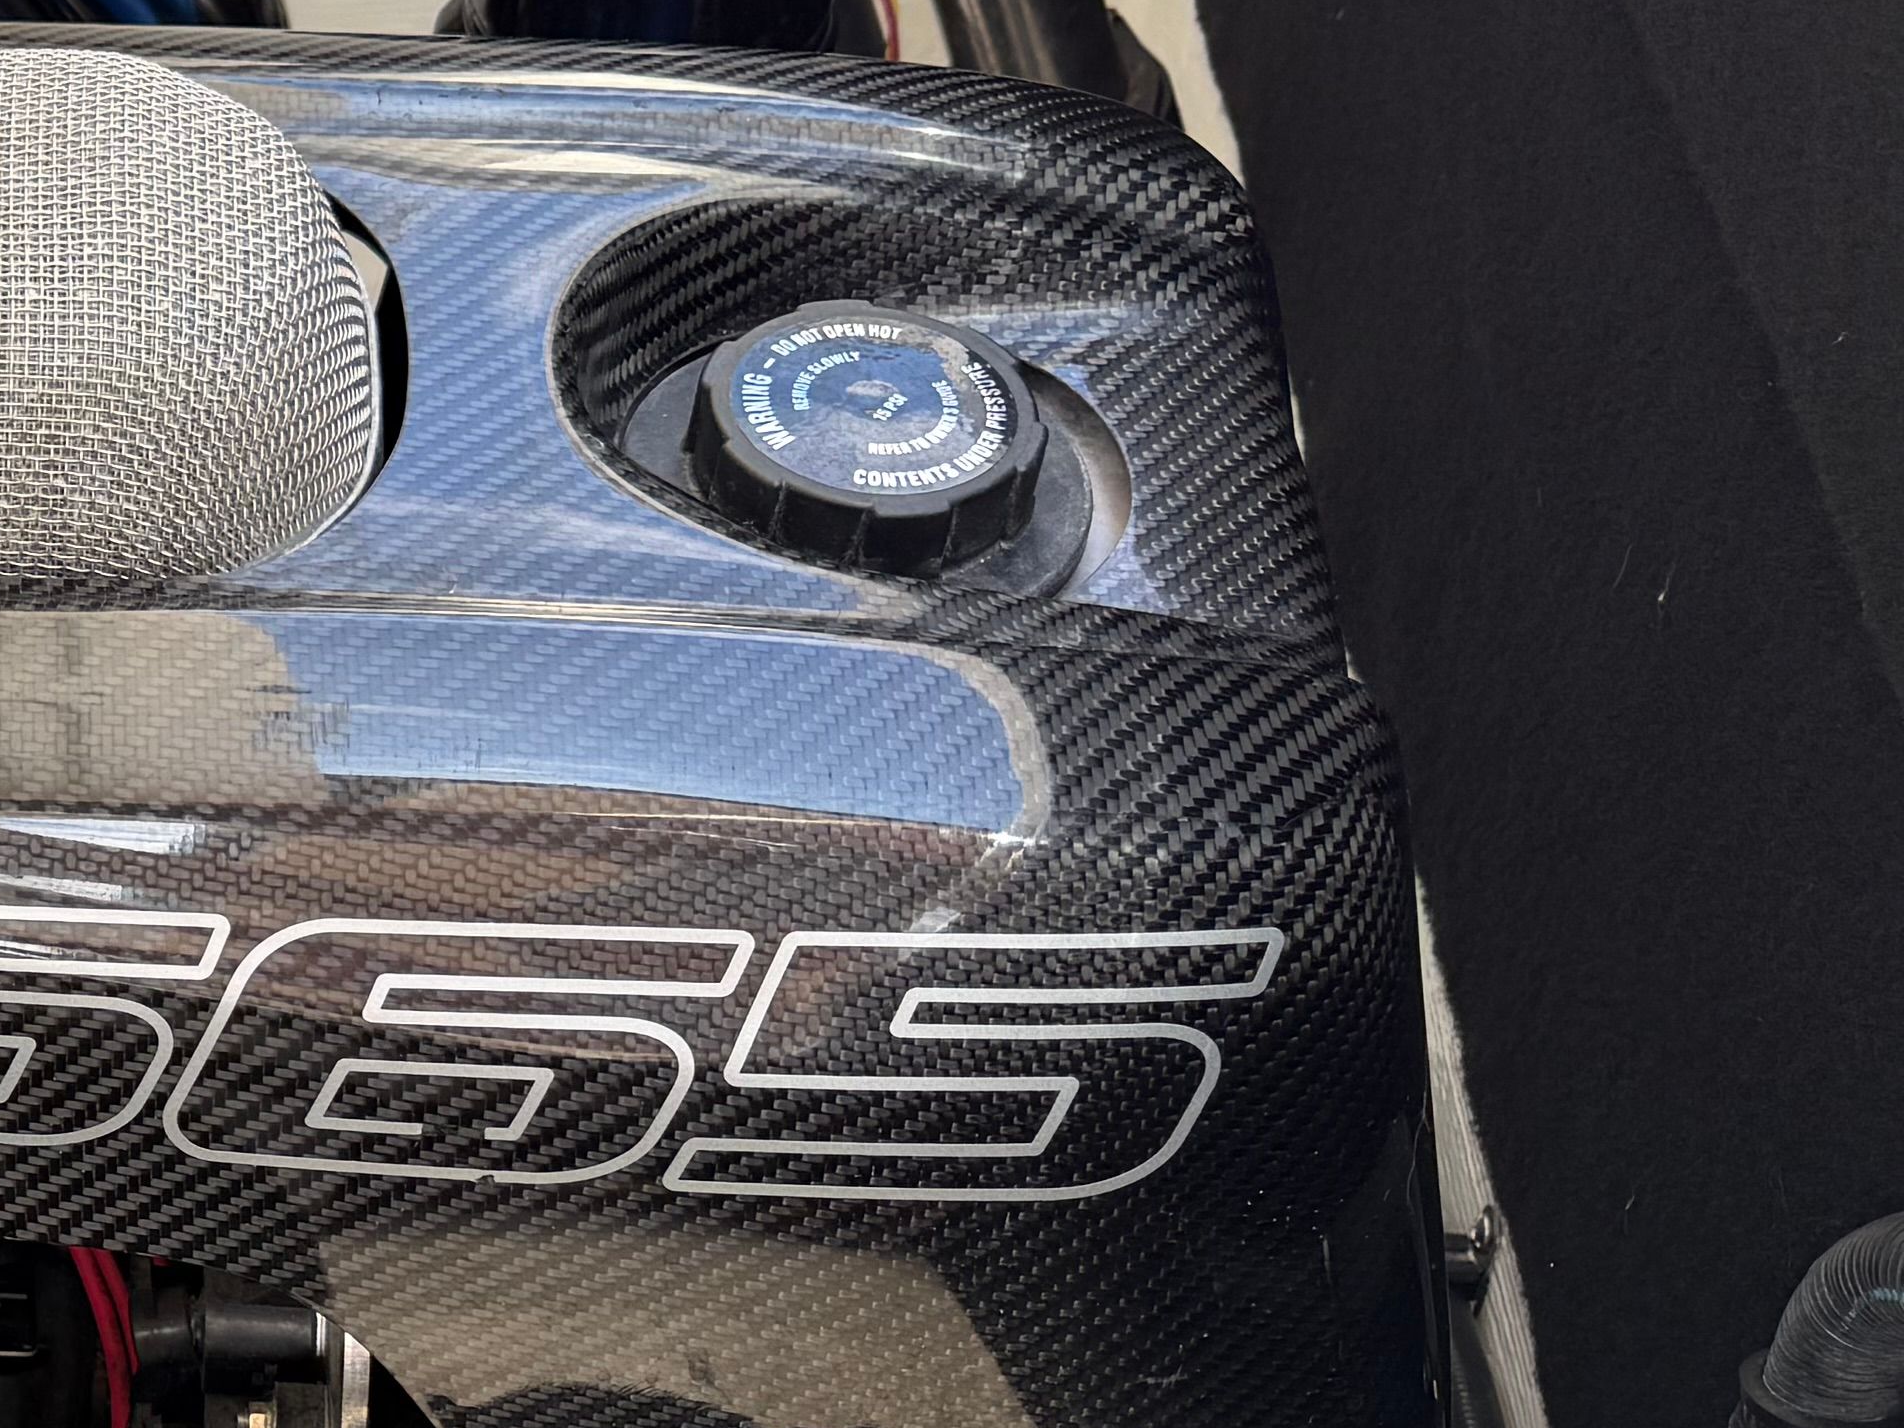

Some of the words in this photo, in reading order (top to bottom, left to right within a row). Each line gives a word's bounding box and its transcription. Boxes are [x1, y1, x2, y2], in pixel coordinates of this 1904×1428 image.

[742, 372, 796, 451] WARNING
[771, 338, 794, 357] DO
[791, 327, 823, 346] NOT
[822, 323, 865, 339] OPEN
[868, 323, 903, 340] HOT
[793, 366, 815, 411] REMOVE
[807, 351, 860, 375] SLOWLY
[961, 362, 1008, 430] PRESSURE
[872, 408, 892, 421] 15
[883, 393, 908, 412] PSI
[853, 462, 960, 488] CONTENTS
[954, 430, 1005, 472] UNDER
